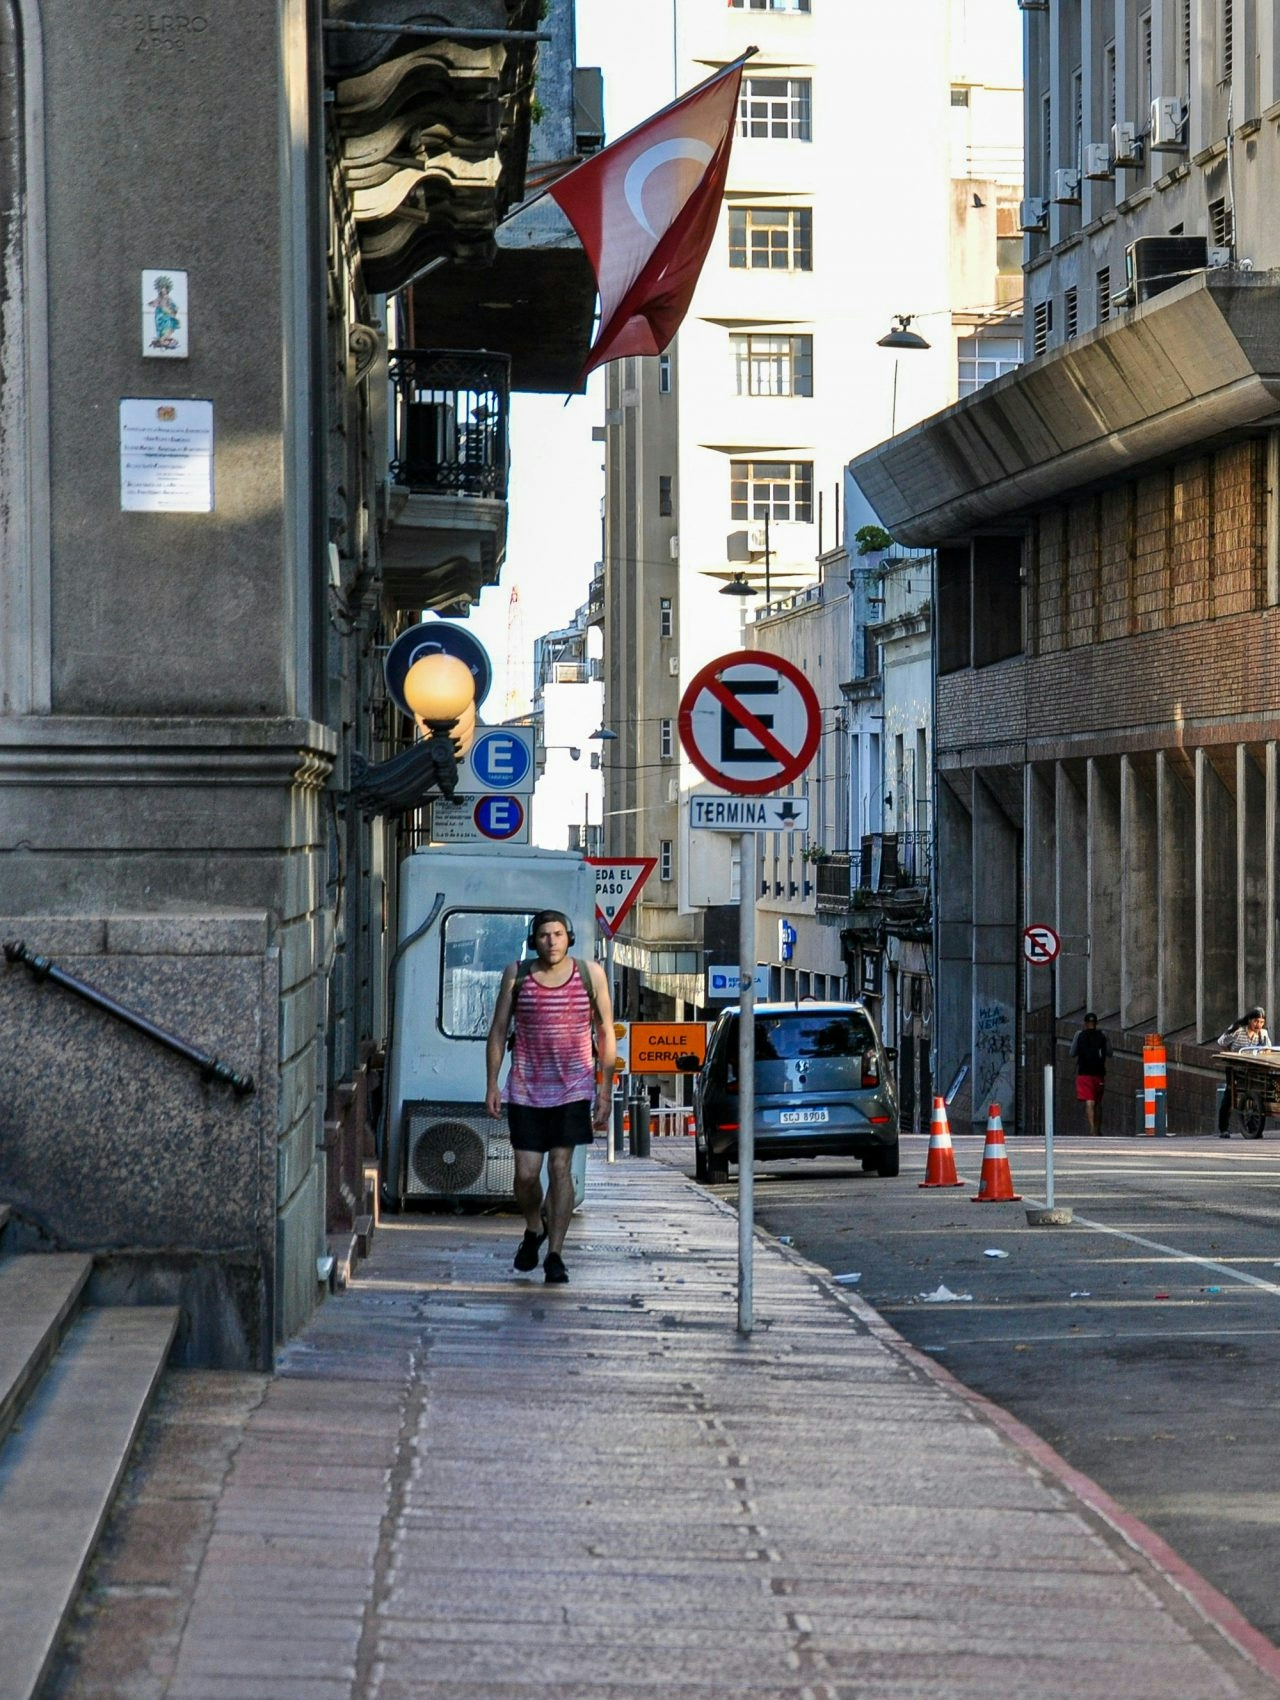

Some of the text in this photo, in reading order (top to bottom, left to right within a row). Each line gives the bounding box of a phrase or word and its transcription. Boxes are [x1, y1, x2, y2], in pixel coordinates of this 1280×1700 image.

[721, 680, 779, 763] E
[487, 740, 514, 774] E
[490, 802, 511, 830] E
[696, 802, 767, 824] TERMINA
[595, 869, 632, 880] EDA EL
[595, 883, 623, 894] PASO
[1031, 933, 1048, 957] E
[648, 1035, 688, 1046] CALLE
[638, 1051, 696, 1062] CERRA
[783, 1111, 826, 1122] SCJ 8908
